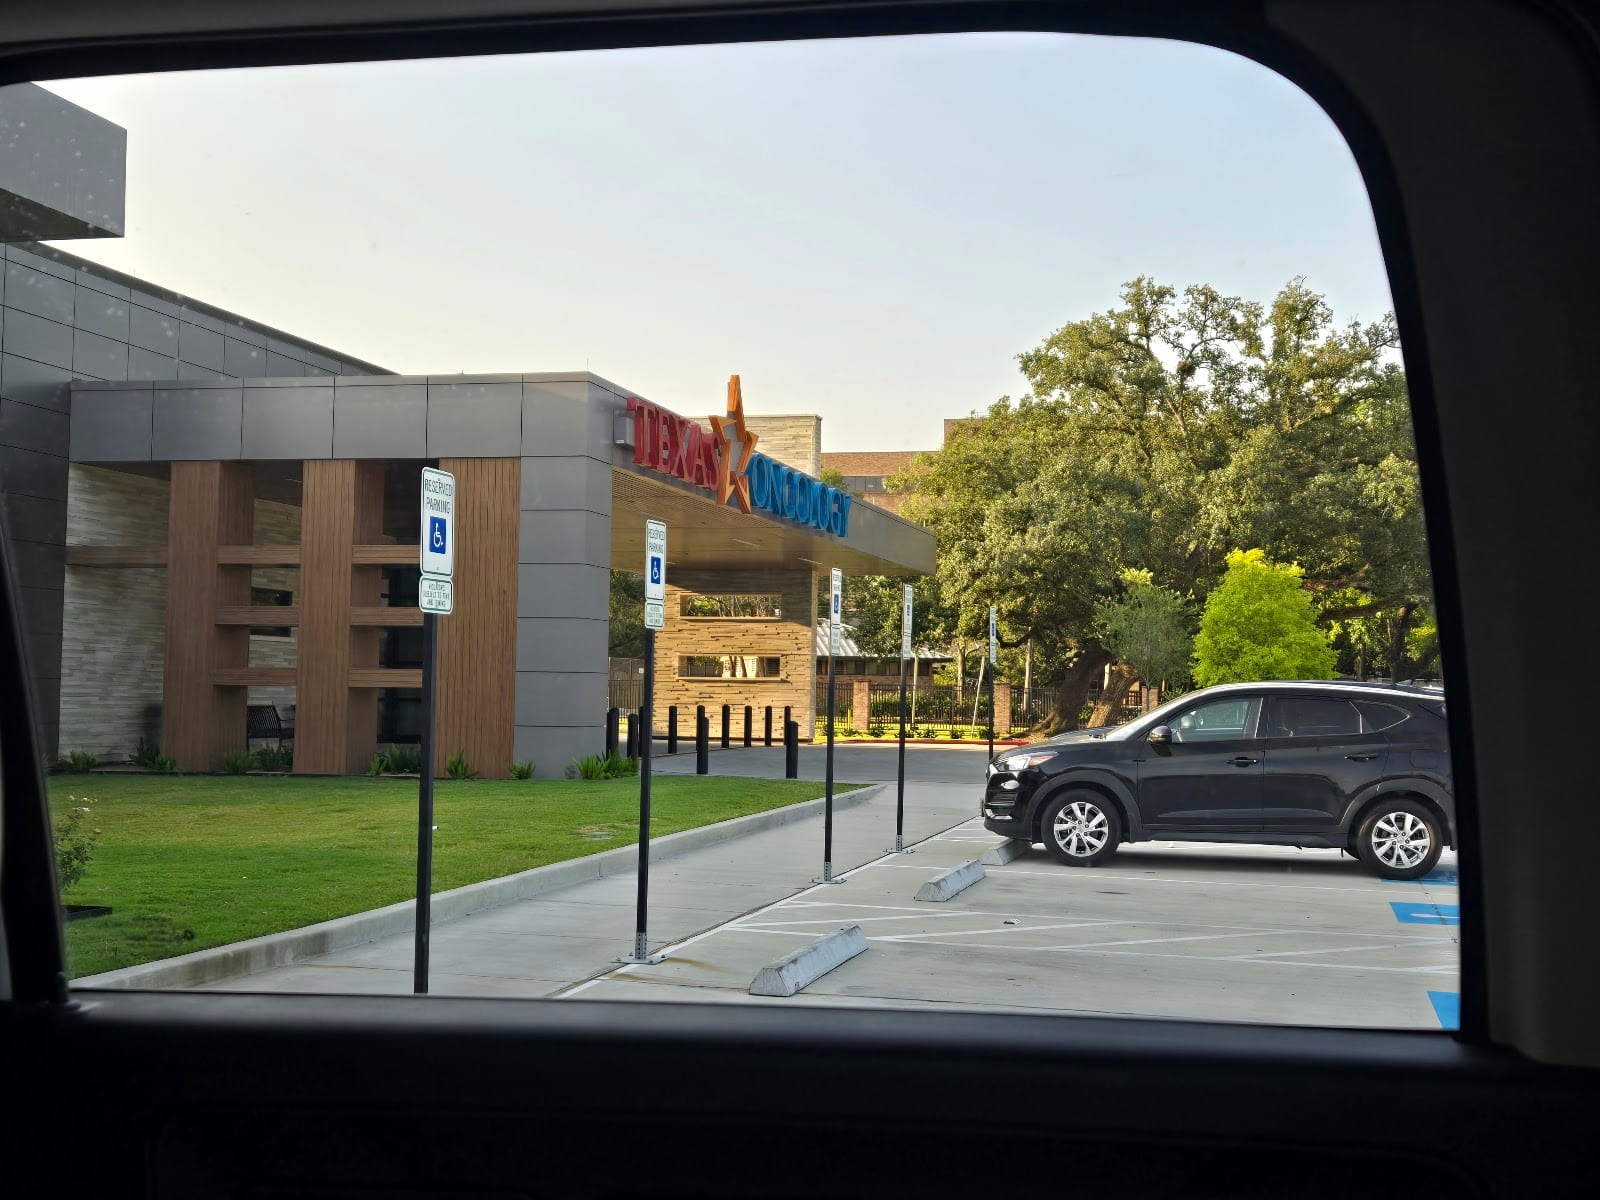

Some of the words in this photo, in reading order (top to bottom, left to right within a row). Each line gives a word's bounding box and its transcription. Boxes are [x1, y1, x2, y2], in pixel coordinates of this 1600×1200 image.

[627, 397, 721, 491] TEXAS
[745, 452, 850, 538] ONCOLOGY
[424, 478, 452, 497] RESERVED
[426, 497, 450, 514] PARKING
